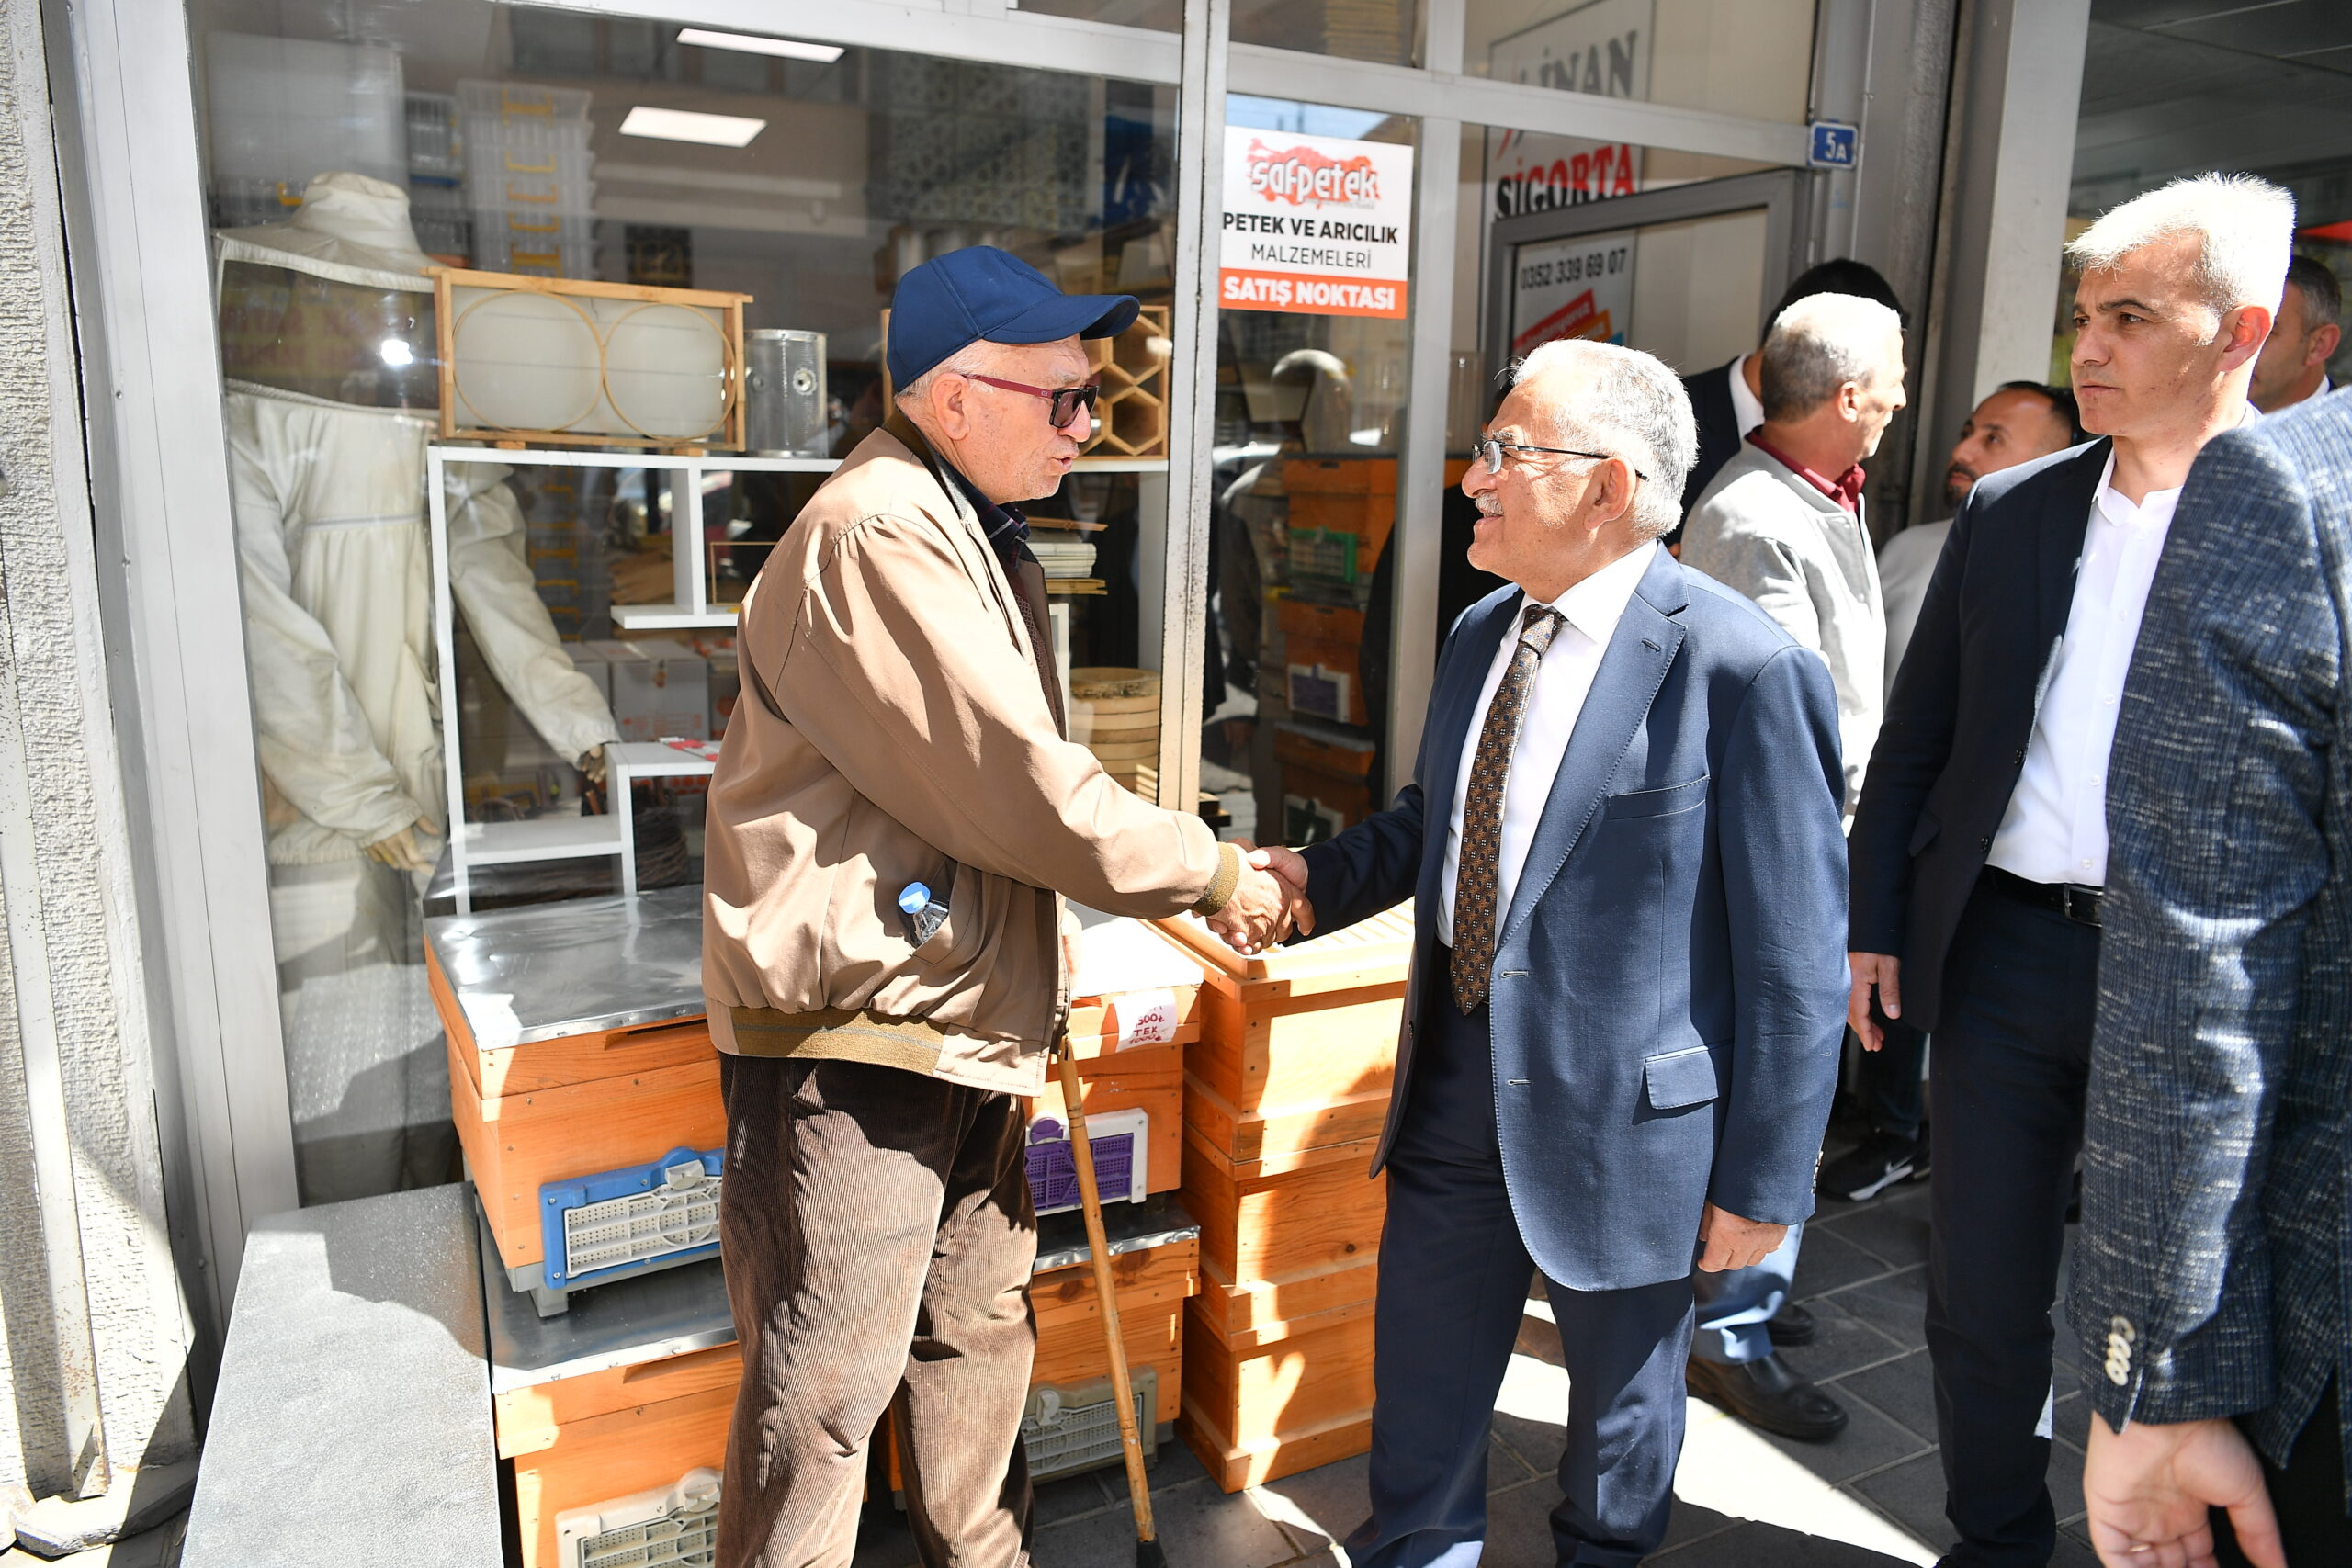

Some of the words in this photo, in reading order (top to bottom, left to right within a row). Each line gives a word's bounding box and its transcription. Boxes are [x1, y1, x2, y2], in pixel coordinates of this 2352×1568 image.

[1825, 130, 1847, 161] 5A
[1223, 212, 1285, 235] PETEK
[1290, 218, 1315, 237] VE
[1319, 221, 1398, 244] ARICILIK
[1251, 243, 1372, 269] MALZEMELERİ
[1223, 276, 1292, 307] SATIŞ
[1295, 281, 1396, 310] NOKTASI
[1133, 1026, 1159, 1037] TEK
